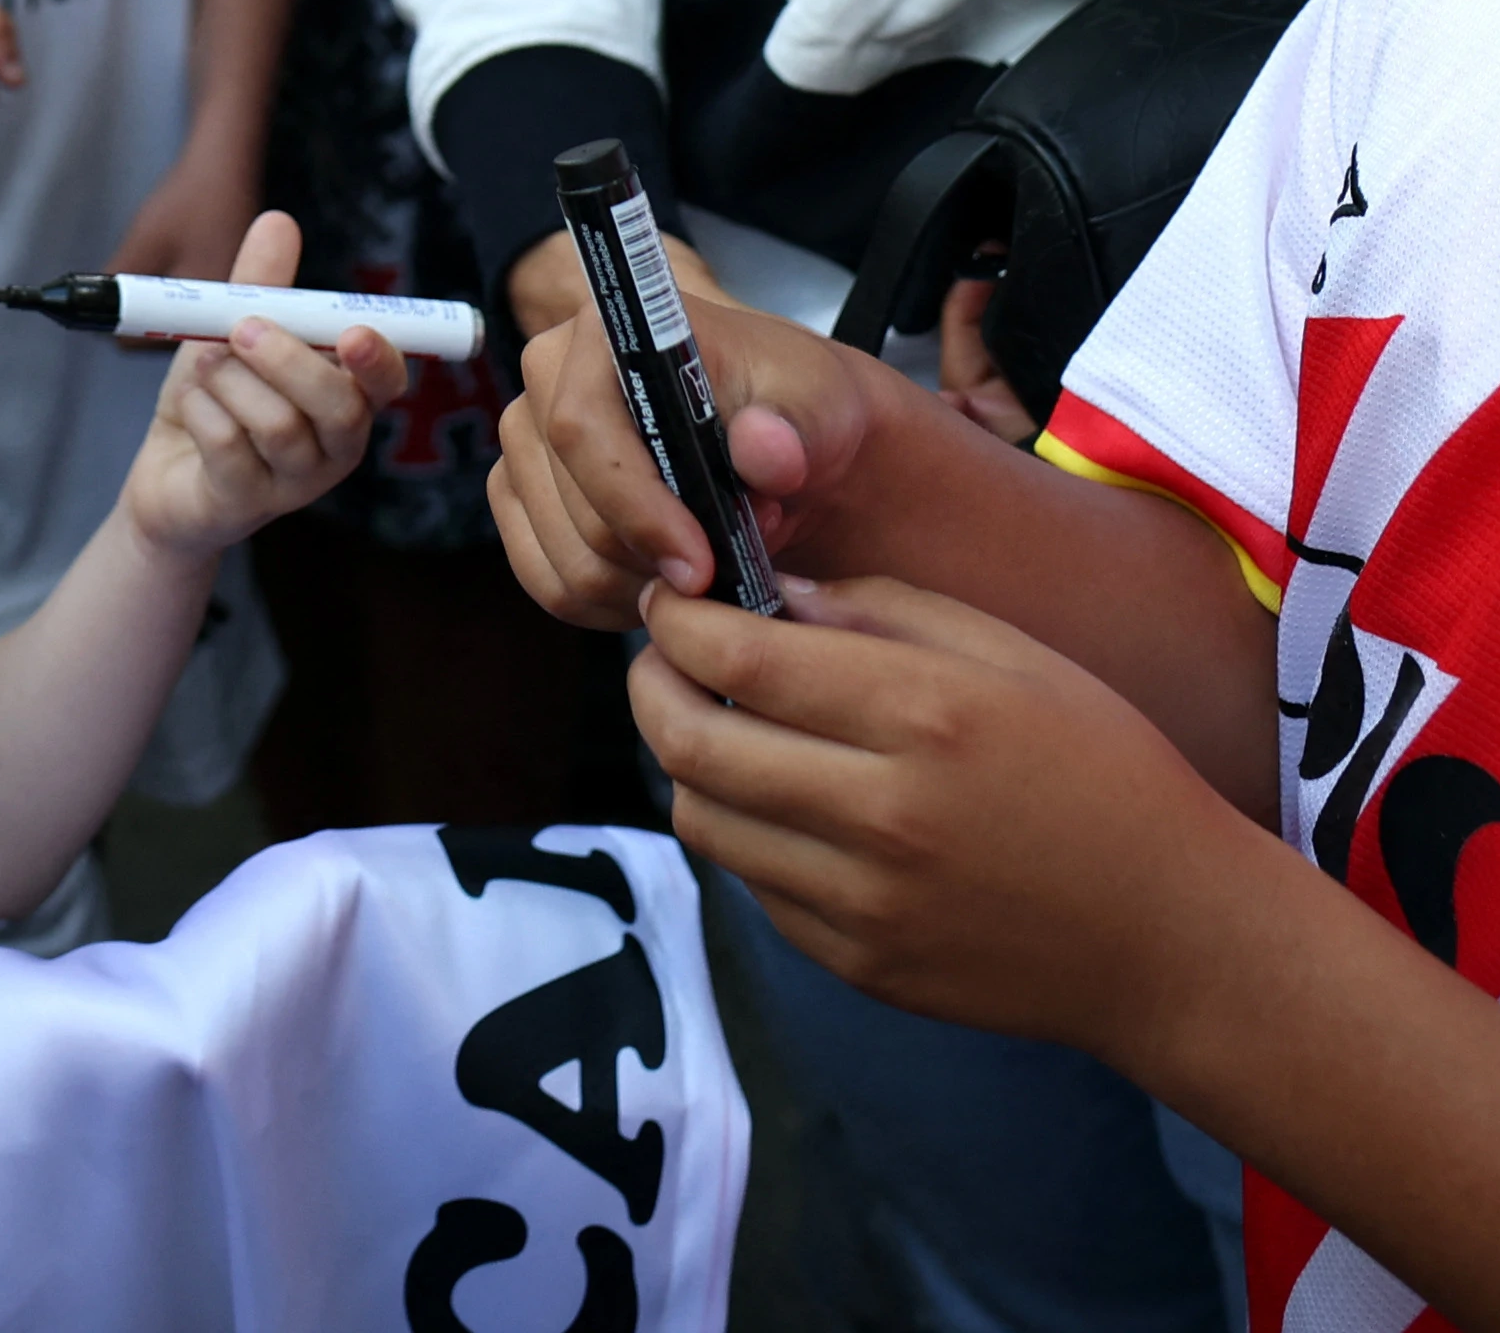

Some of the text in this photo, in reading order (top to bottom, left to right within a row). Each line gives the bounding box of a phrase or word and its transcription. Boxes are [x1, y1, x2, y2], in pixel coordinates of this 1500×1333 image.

[580, 223, 629, 354] Marcador Permanente
[612, 288, 642, 353] Pennarello
[627, 370, 682, 498] anent Marker
